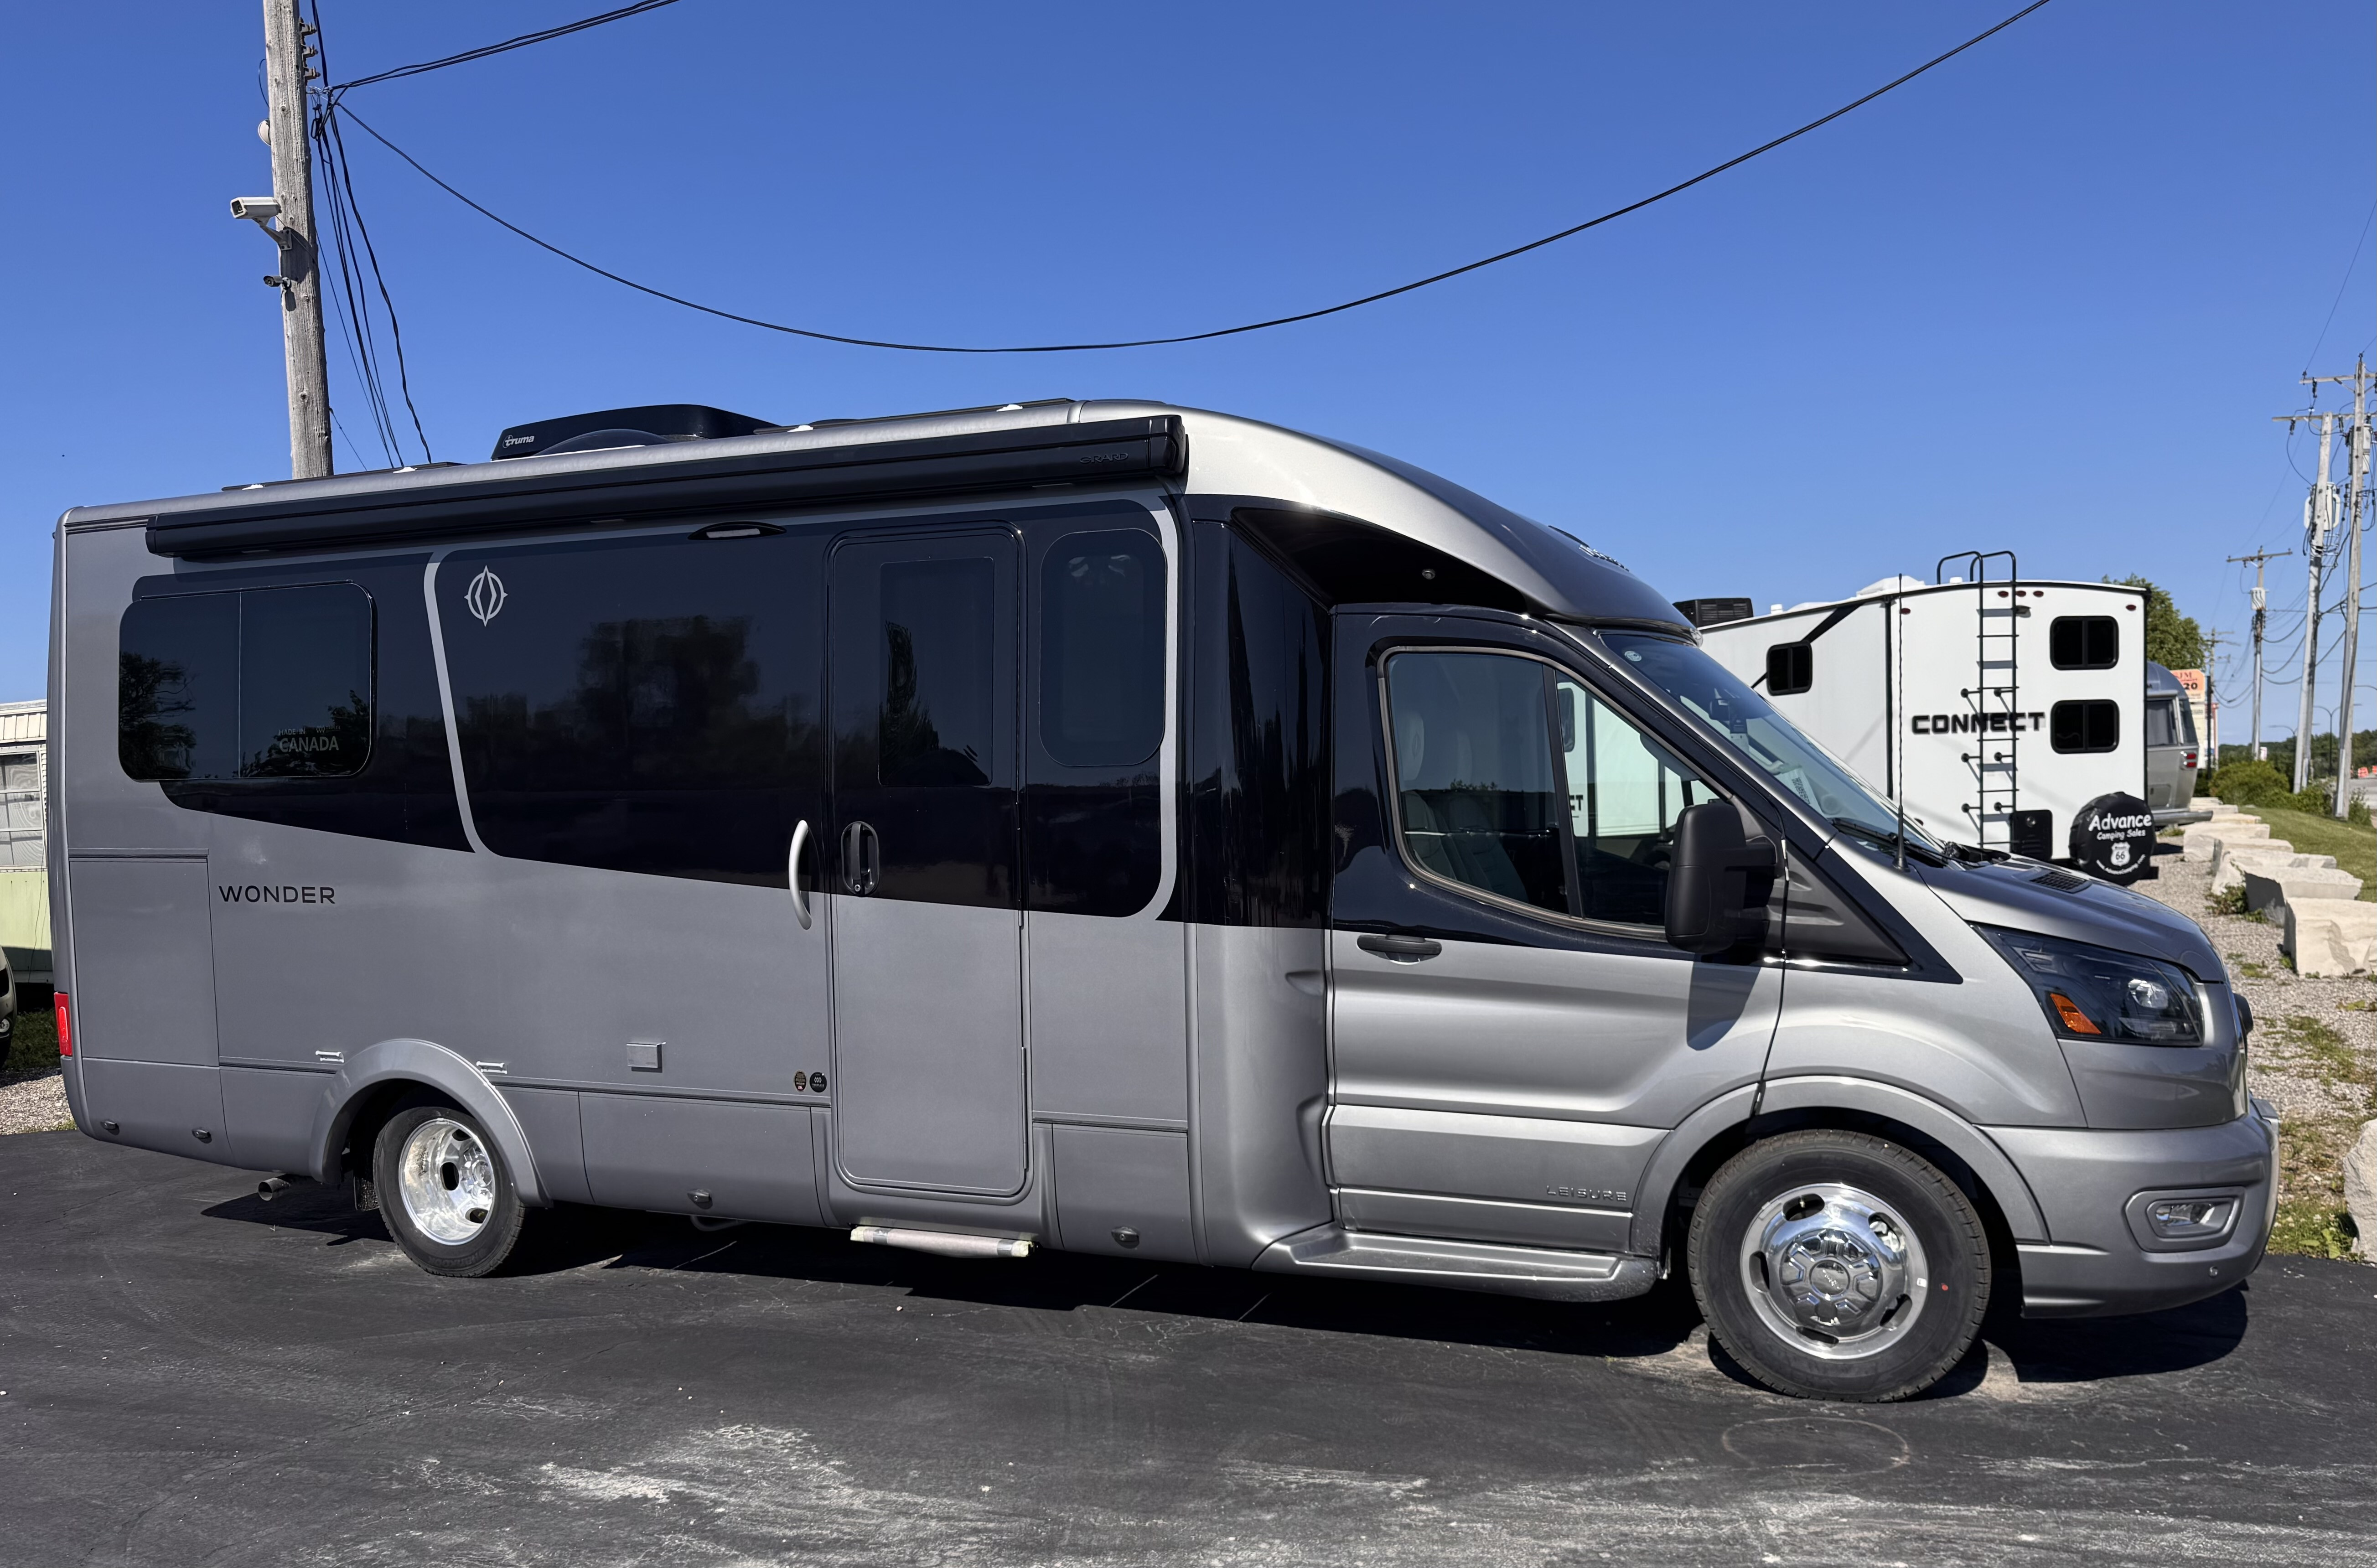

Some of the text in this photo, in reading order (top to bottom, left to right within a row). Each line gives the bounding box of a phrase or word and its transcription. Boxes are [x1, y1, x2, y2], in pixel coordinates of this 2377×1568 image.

[504, 435, 534, 446] truma
[1911, 712, 2046, 735] CONNECT
[279, 736, 339, 752] CANADA
[2088, 812, 2152, 831] Advance
[2097, 828, 2146, 841] Camping Sales
[2116, 851, 2125, 860] 66
[218, 885, 336, 904] WONDER
[1547, 1185, 1626, 1201] LEISURE
